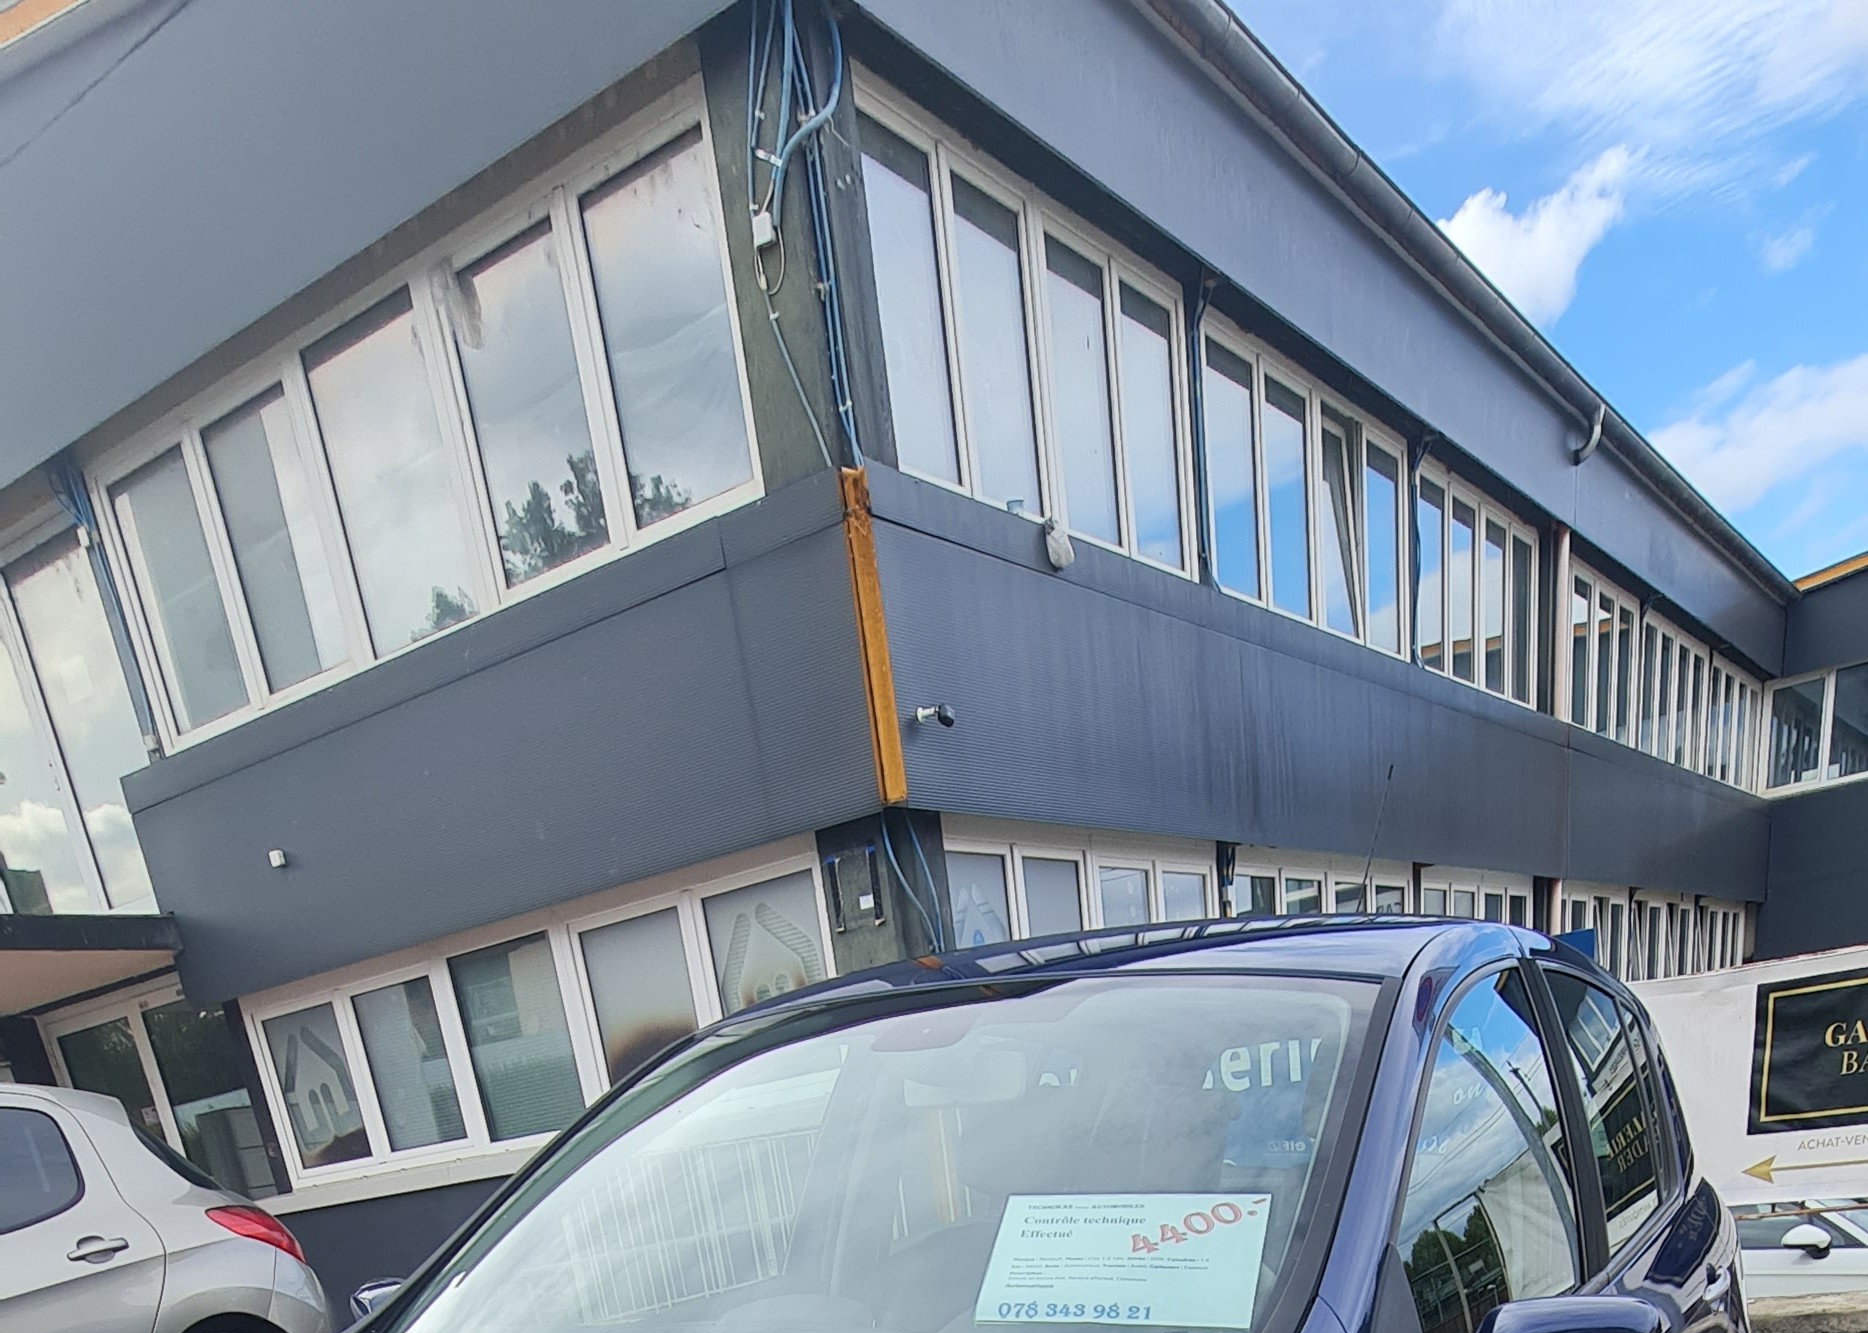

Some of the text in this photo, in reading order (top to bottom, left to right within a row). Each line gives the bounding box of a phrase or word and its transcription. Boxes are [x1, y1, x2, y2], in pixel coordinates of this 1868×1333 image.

[1024, 1215, 1147, 1226] Contrôle technique
[1020, 1229, 1073, 1239] Effectué
[998, 1300, 1151, 1321] 078 343 98 21
